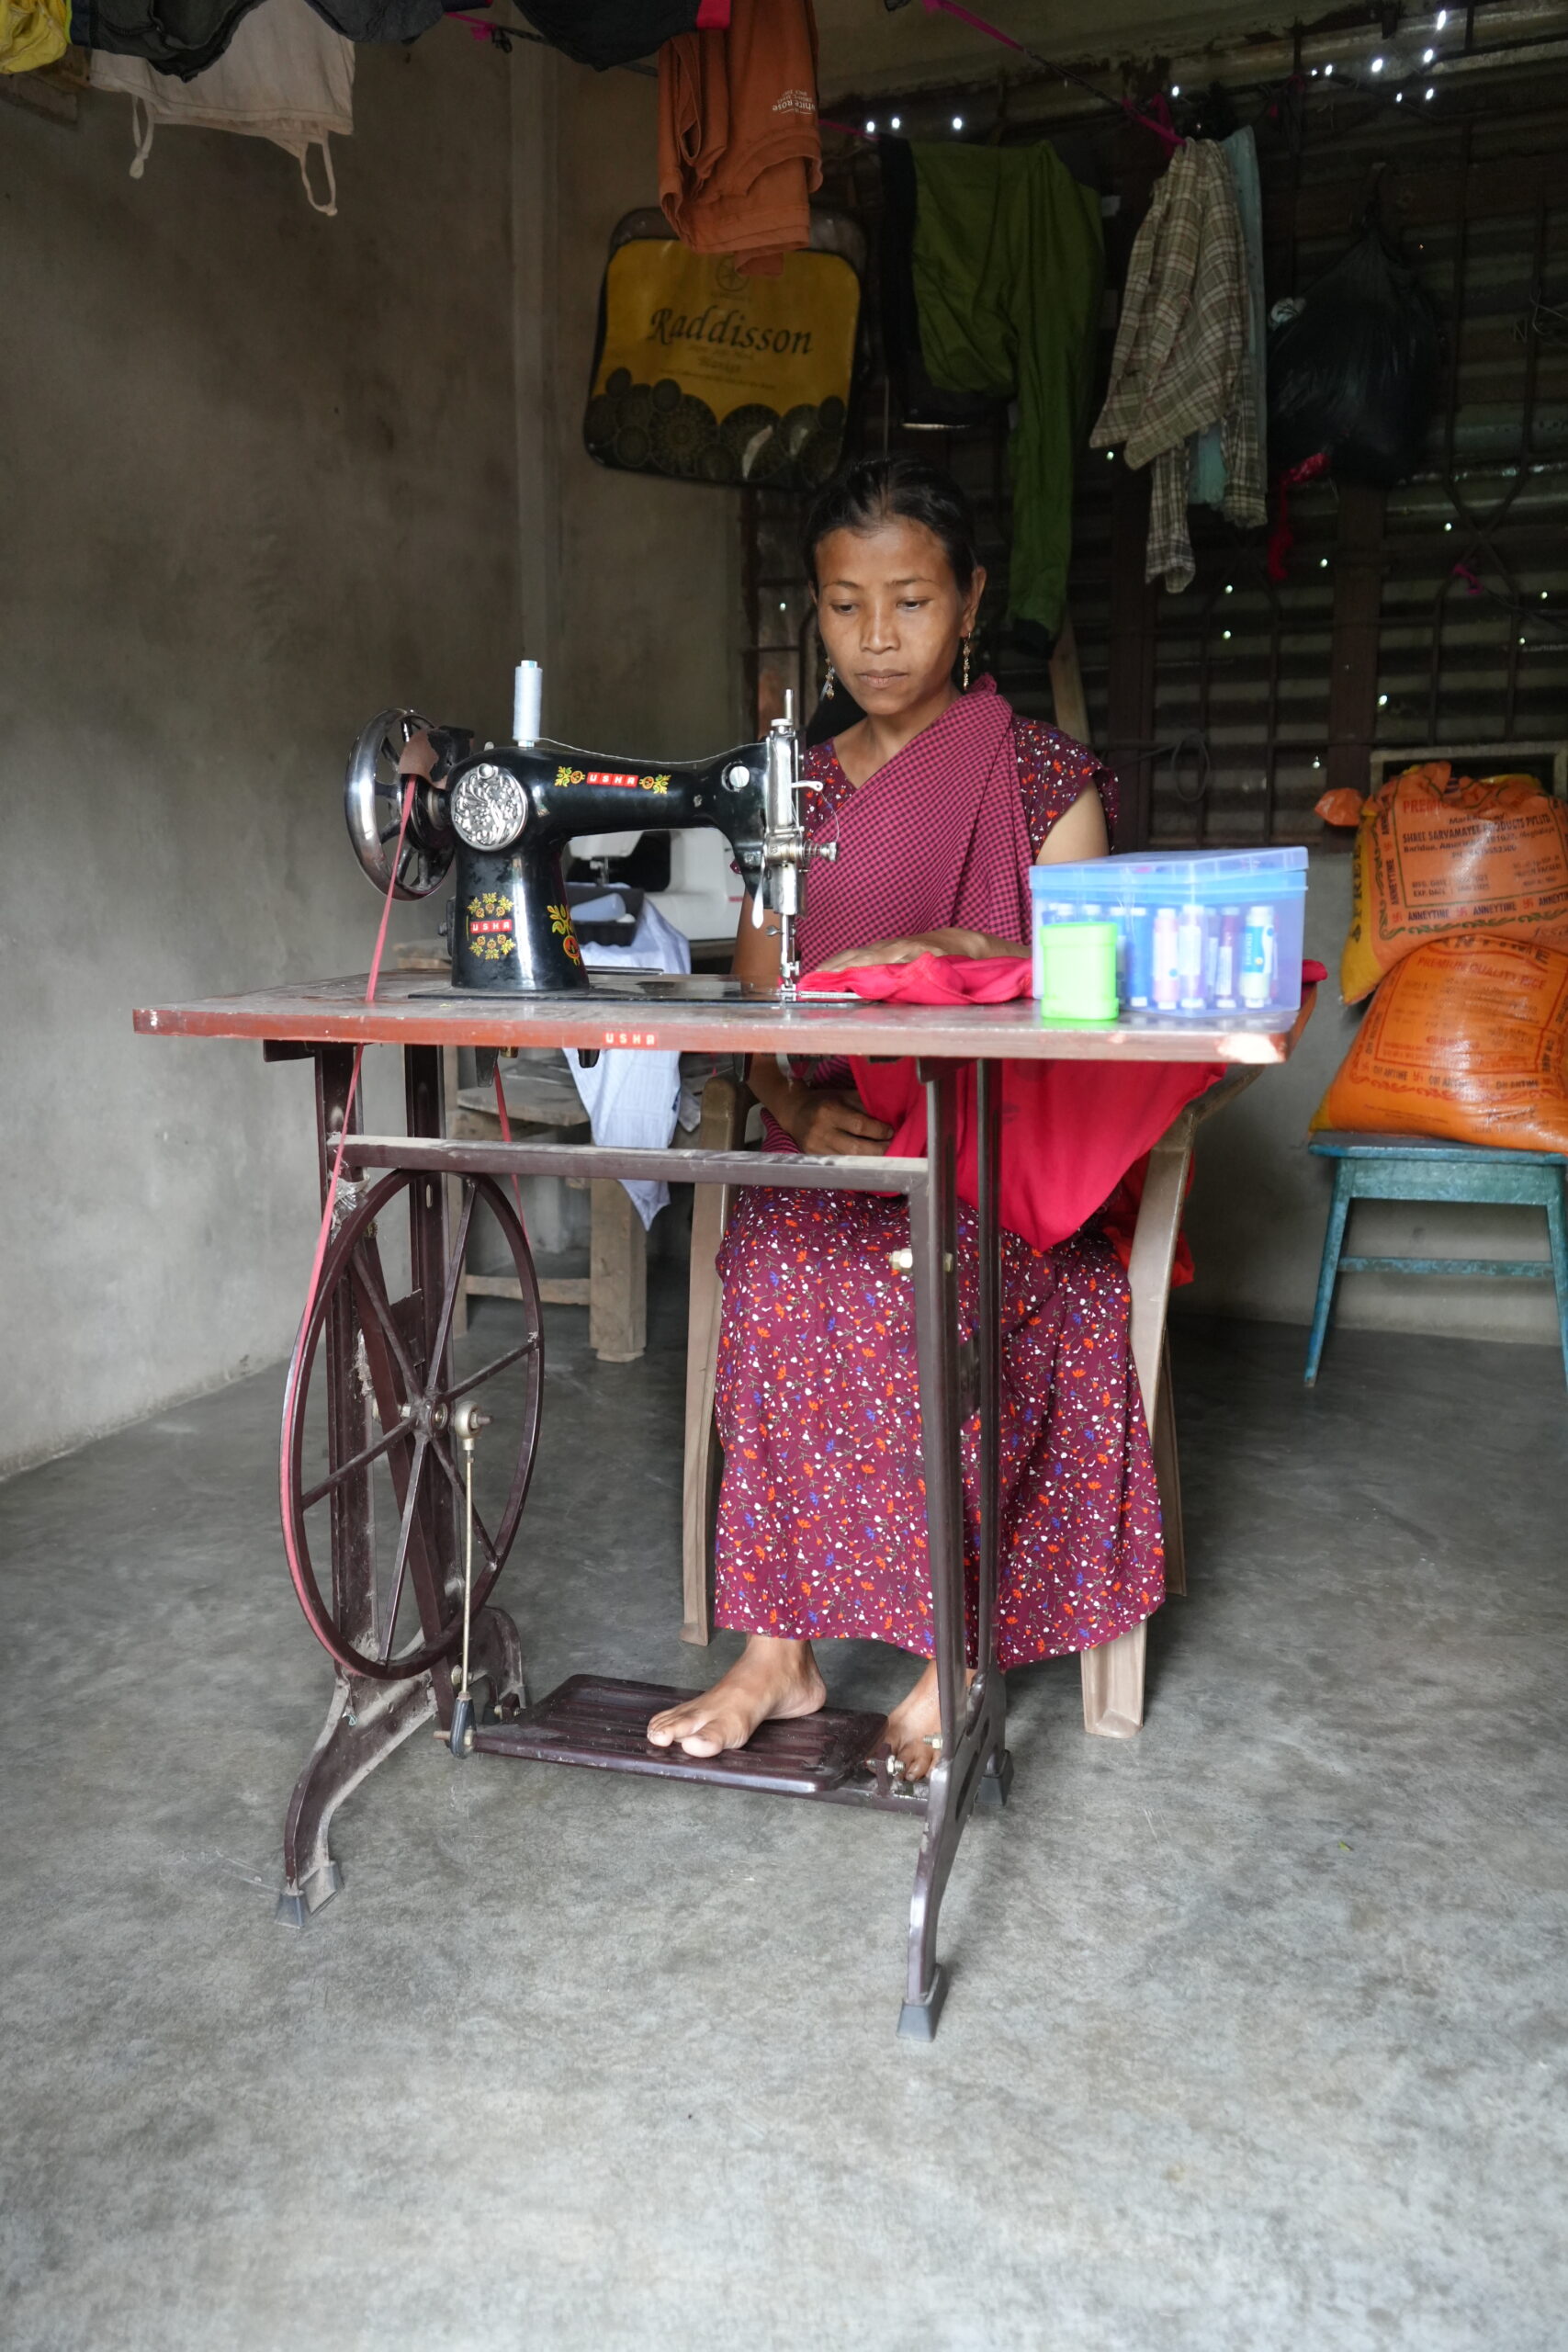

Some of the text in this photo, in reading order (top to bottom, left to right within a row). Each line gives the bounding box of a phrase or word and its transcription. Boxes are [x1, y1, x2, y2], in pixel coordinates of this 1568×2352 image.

[647, 304, 814, 355] Raddisson
[590, 775, 636, 786] USHA
[1403, 831, 1426, 843] SHREE
[1408, 908, 1450, 922] ANNEYTIME
[1473, 901, 1517, 916] ANNEYTIME
[472, 921, 510, 932] USHA
[1470, 963, 1519, 981] QUALITY
[1519, 977, 1547, 990] RICE
[605, 1033, 655, 1046] USHA
